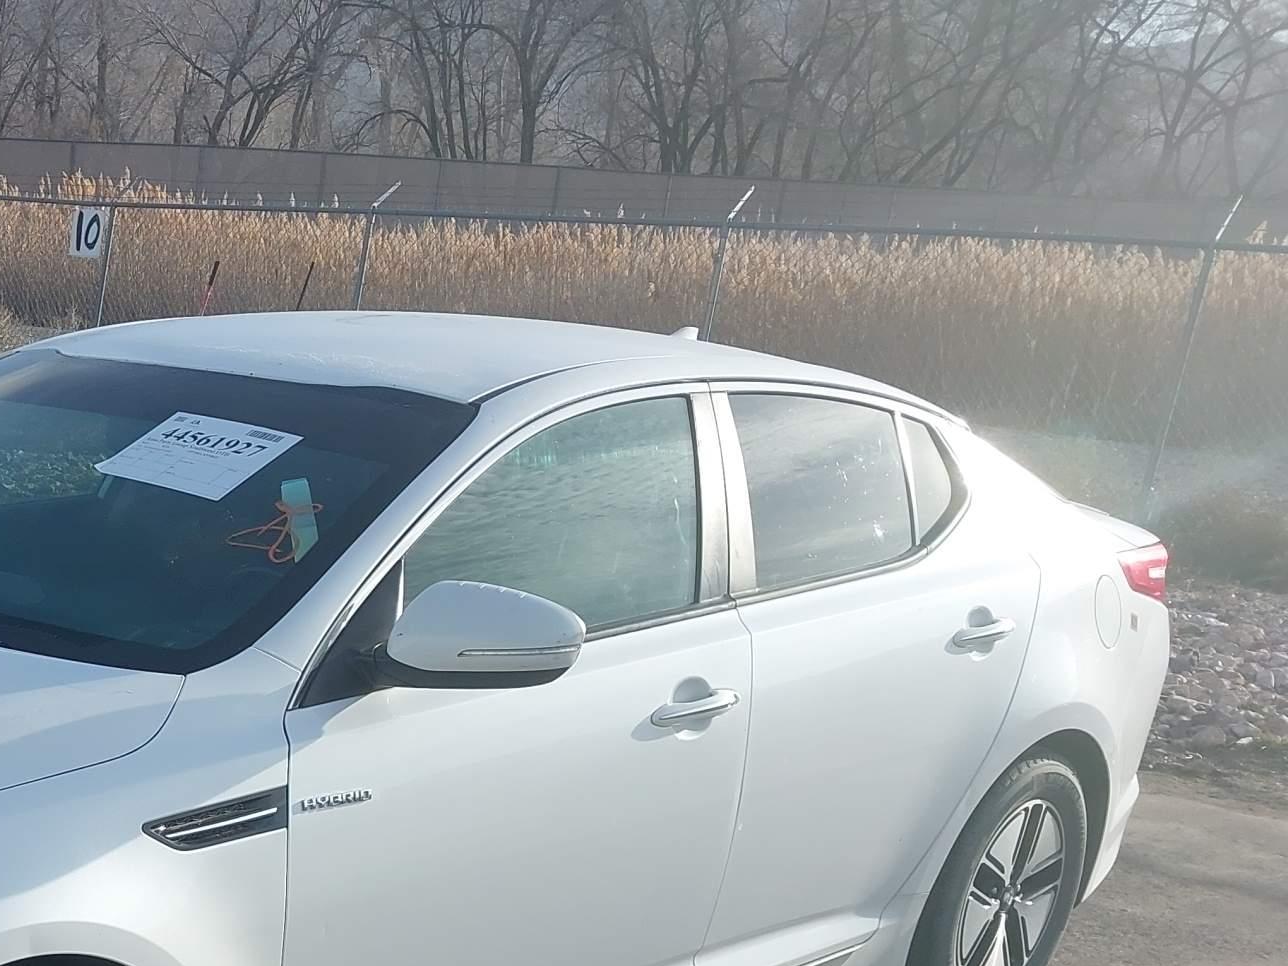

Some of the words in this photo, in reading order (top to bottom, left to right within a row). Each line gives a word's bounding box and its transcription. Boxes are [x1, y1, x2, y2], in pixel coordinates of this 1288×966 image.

[76, 210, 101, 251] 10
[161, 427, 268, 457] 44561927
[299, 789, 372, 811] HYBRID
